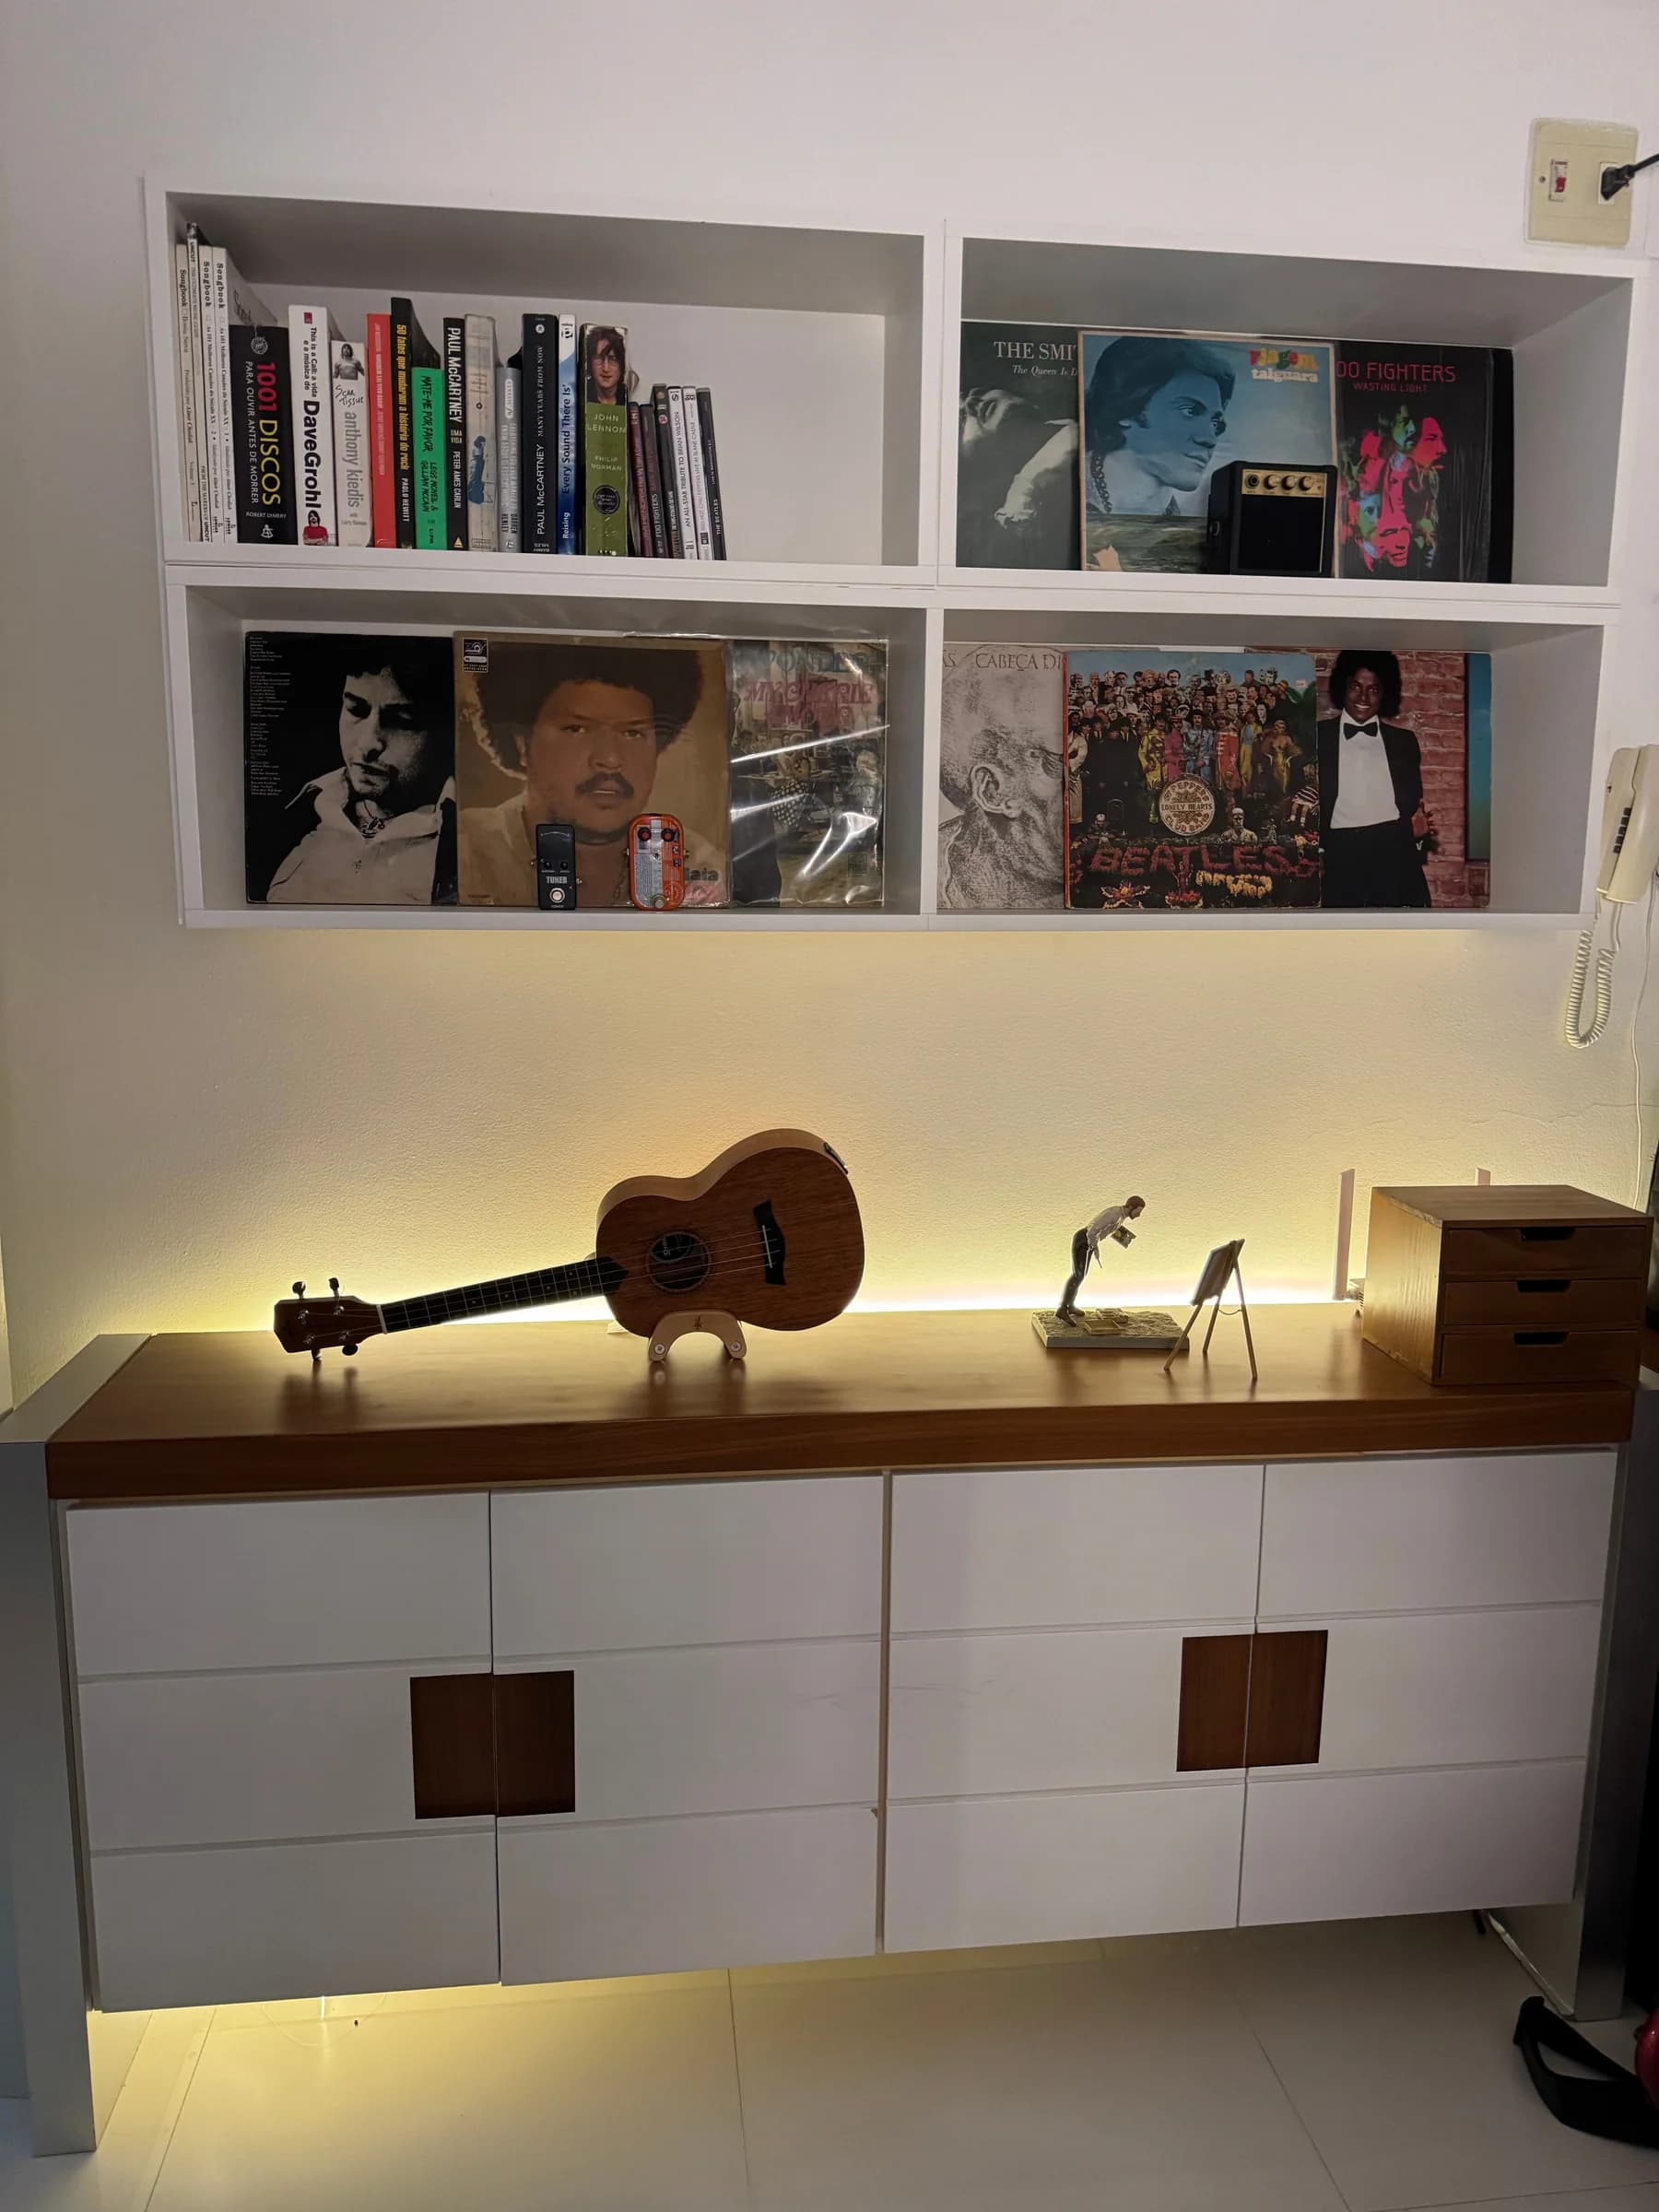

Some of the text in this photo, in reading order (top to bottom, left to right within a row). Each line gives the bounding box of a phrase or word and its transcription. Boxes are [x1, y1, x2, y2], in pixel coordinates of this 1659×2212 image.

[179, 269, 189, 308] Songbook
[202, 261, 212, 308] Songbook
[215, 263, 226, 310] Songbook
[311, 326, 320, 342] This
[396, 324, 407, 335] 50
[311, 343, 320, 351] is
[396, 335, 407, 356] fatos
[993, 341, 1034, 359] THE
[312, 359, 320, 375] Call:
[396, 356, 407, 370] que
[1012, 365, 1029, 374] The
[1030, 366, 1057, 377] Queen
[1069, 368, 1077, 377] D
[1336, 360, 1455, 382] OO FIGHTERS
[305, 380, 312, 391] de
[447, 327, 463, 423] PAUL McCARTNEY
[312, 382, 320, 398] vida
[397, 371, 408, 406] mudaram
[1353, 382, 1427, 394] WASTING LIGHT
[338, 395, 365, 407] Tissue
[420, 375, 434, 453] MATE-ME POR FAVOR
[559, 398, 571, 428] There
[594, 413, 620, 422] JOHN
[245, 361, 260, 504] PARA OUVIR ANTES DE MORRER
[256, 362, 282, 506] 1001 DISCOS
[398, 413, 410, 441] história
[586, 423, 627, 434] LENNON
[689, 421, 698, 440] CASTLE
[341, 411, 362, 466] anthony
[400, 441, 410, 453] do
[535, 345, 546, 535] PAUL McCARTNEY MANY YEARS FROM NOW
[560, 430, 571, 464] Sound
[303, 399, 322, 508] DaveGrohl
[400, 453, 411, 471] rock
[594, 455, 619, 464] PHILIP
[420, 461, 429, 488] GILLIAN
[429, 462, 439, 479] LEGS
[590, 463, 623, 472] NORMAN
[673, 411, 692, 527] AN ALL-STAR TRIBUTE TO BRIAN WILSON
[347, 468, 365, 509] kiedis
[453, 451, 463, 509] PETER AMES CARLIN
[560, 465, 572, 495] Every
[401, 477, 410, 523] PAOLO HEWITT
[652, 493, 661, 524] FIGHTERS
[712, 498, 722, 524] BEATLES
[976, 653, 1062, 671] CABEÇA DI
[1165, 813, 1210, 832] CLUB BAND
[1088, 844, 1294, 877] BEATLES
[546, 876, 568, 884] TUNER
